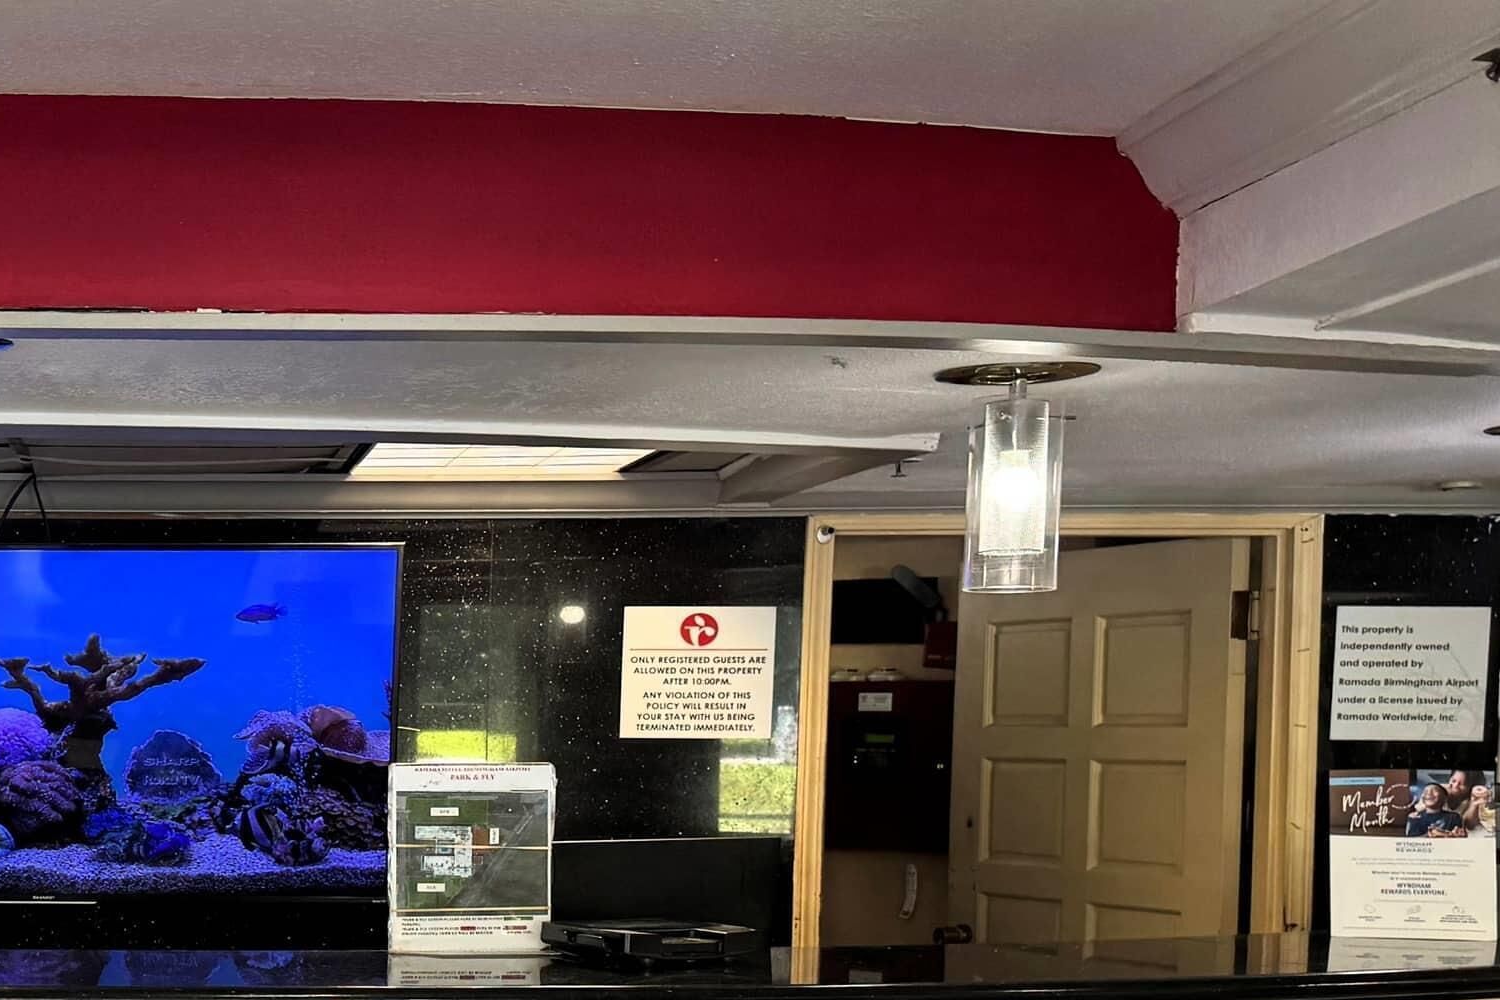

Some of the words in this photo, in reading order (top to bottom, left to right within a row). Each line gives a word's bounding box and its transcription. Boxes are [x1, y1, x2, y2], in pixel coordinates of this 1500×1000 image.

[1342, 625, 1358, 633] This
[1362, 626, 1404, 635] property
[1415, 643, 1450, 651] owned
[713, 656, 745, 664] GUESTS
[1362, 660, 1408, 669] operated
[1411, 660, 1424, 669] by
[1339, 678, 1380, 686] Ramada
[1384, 678, 1442, 688] Birmingham
[1446, 679, 1478, 688] Airport
[1450, 697, 1463, 706] by
[1337, 713, 1379, 721] Ramada
[1342, 786, 1394, 814] Member
[1350, 806, 1395, 832] Month
